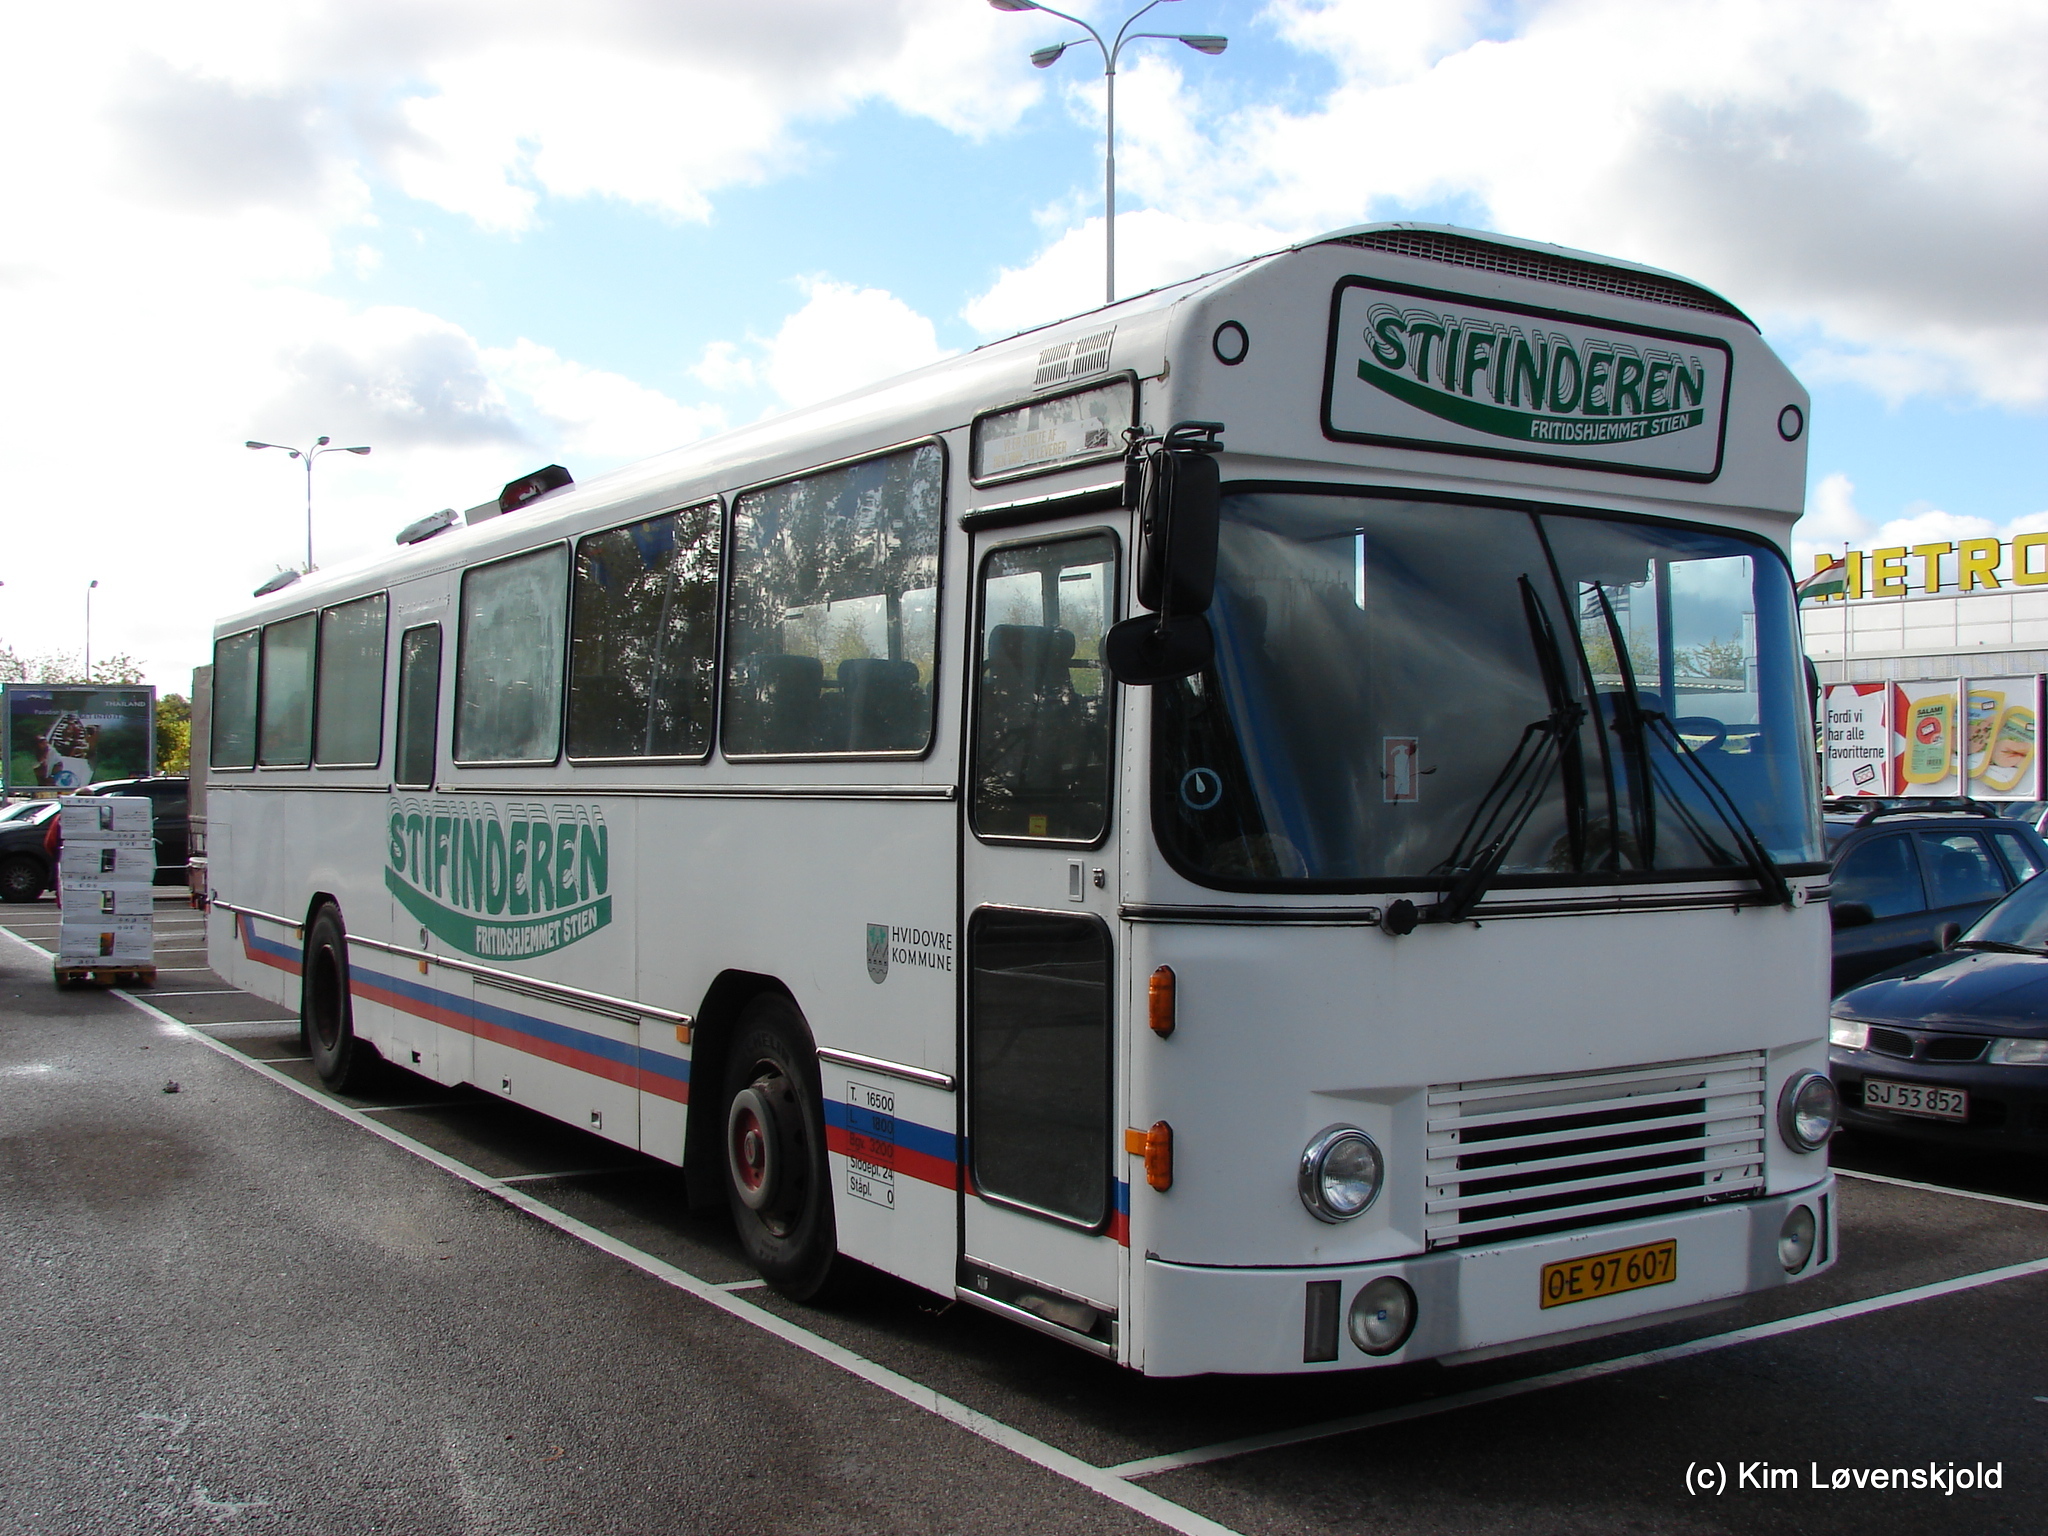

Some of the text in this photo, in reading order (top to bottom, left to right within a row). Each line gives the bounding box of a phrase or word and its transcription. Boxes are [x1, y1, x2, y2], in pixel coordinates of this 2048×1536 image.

[1363, 303, 1704, 416] STIFINDEREN
[1530, 414, 1690, 442] FRITIDSHJEMMET STIEN
[1814, 532, 2048, 603] METRO
[1828, 709, 1863, 723] Fordi vi
[1916, 706, 1943, 716] SALAMI
[1828, 726, 1865, 741] har alle
[1828, 745, 1885, 759] favoritterne
[386, 797, 609, 916] STIFINDEREN
[476, 906, 598, 956] FRITIDSHJEMMET STIEN
[892, 926, 952, 951] HVIDOVRE
[892, 947, 952, 972] KOMMUNE
[850, 1086, 894, 1111] T. 16500
[1867, 1084, 1963, 1113] SJ 53 852
[872, 1116, 893, 1135] 1800
[850, 1176, 894, 1204] Ståpl. 0
[1548, 1265, 1583, 1300] OE
